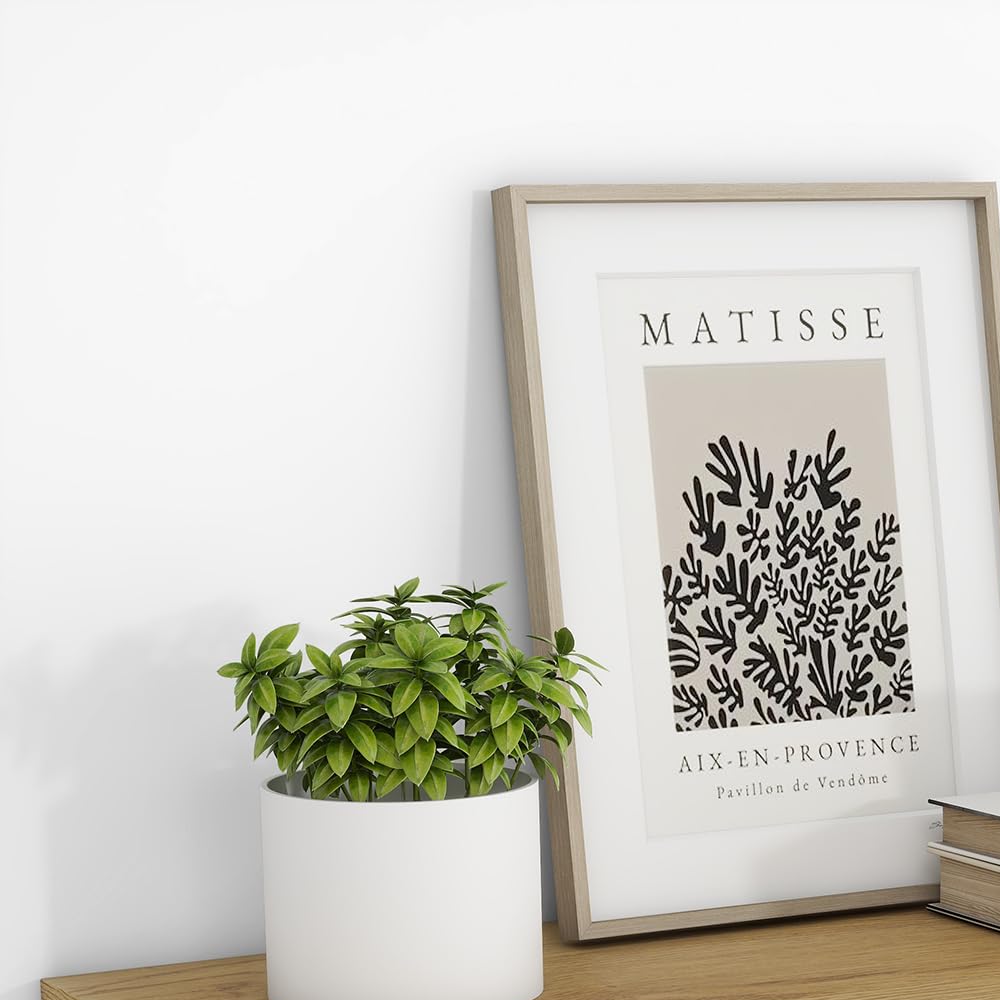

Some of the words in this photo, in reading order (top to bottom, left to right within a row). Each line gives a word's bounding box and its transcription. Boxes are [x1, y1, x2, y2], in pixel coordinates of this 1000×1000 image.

[639, 307, 884, 346] MATISSE
[678, 734, 920, 773] AIX-EN-PROVENCE
[716, 782, 784, 799] Pavillon
[793, 778, 809, 792] de
[817, 773, 889, 789] Vendôme
